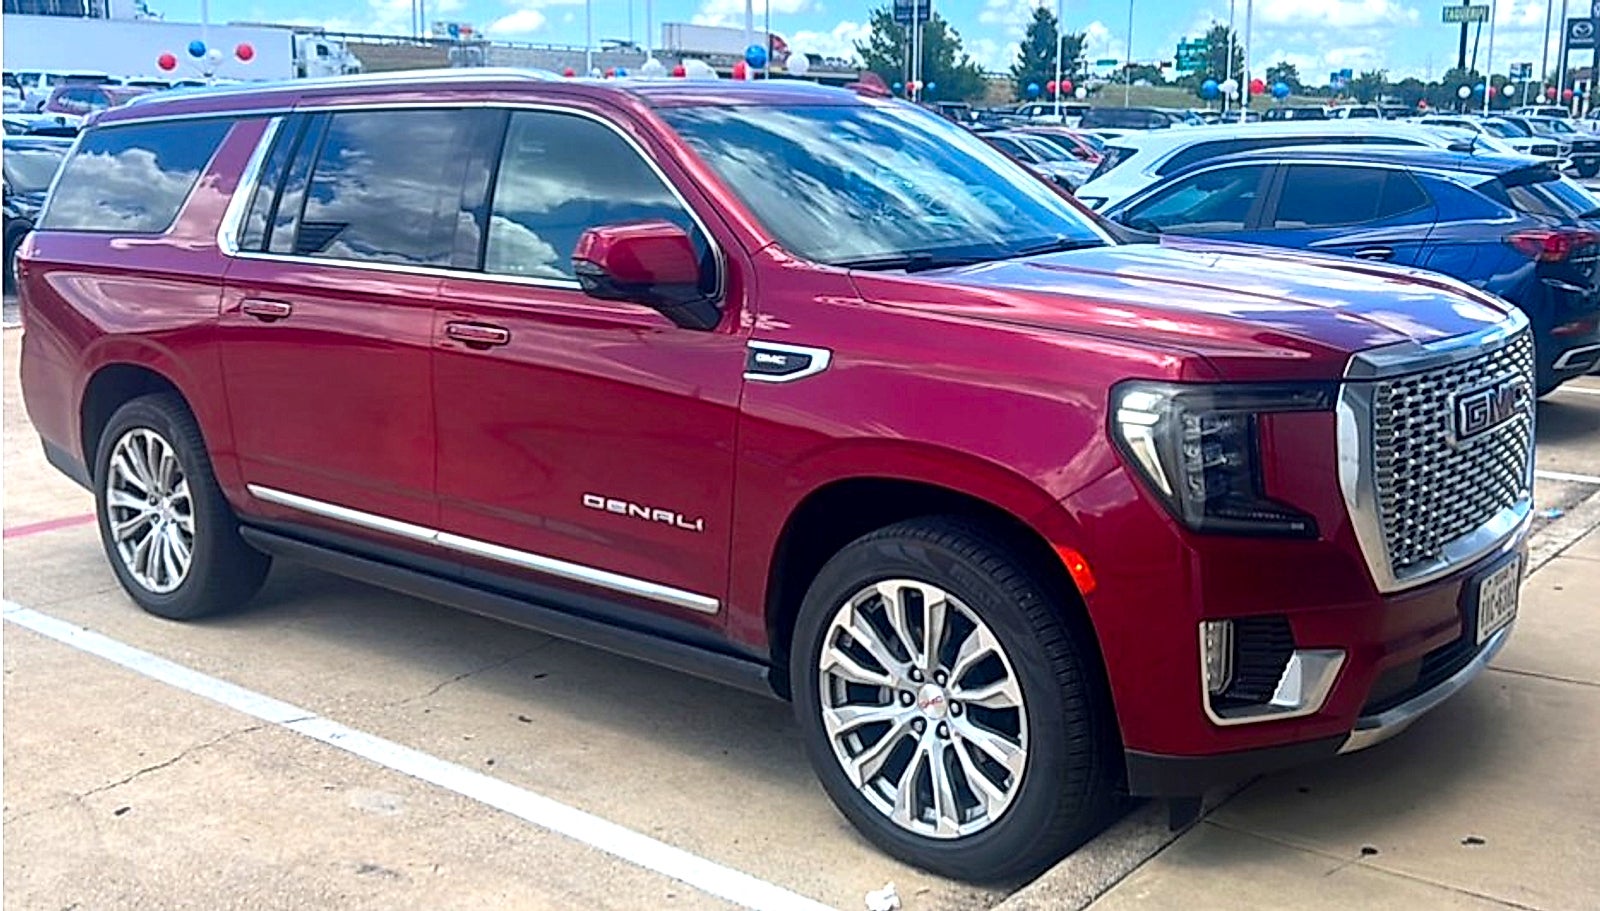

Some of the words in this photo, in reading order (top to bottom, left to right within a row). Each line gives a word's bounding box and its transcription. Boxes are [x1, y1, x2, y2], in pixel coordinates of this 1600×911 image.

[755, 352, 787, 365] GMC
[1459, 374, 1527, 437] GMC
[582, 493, 704, 532] DENALI
